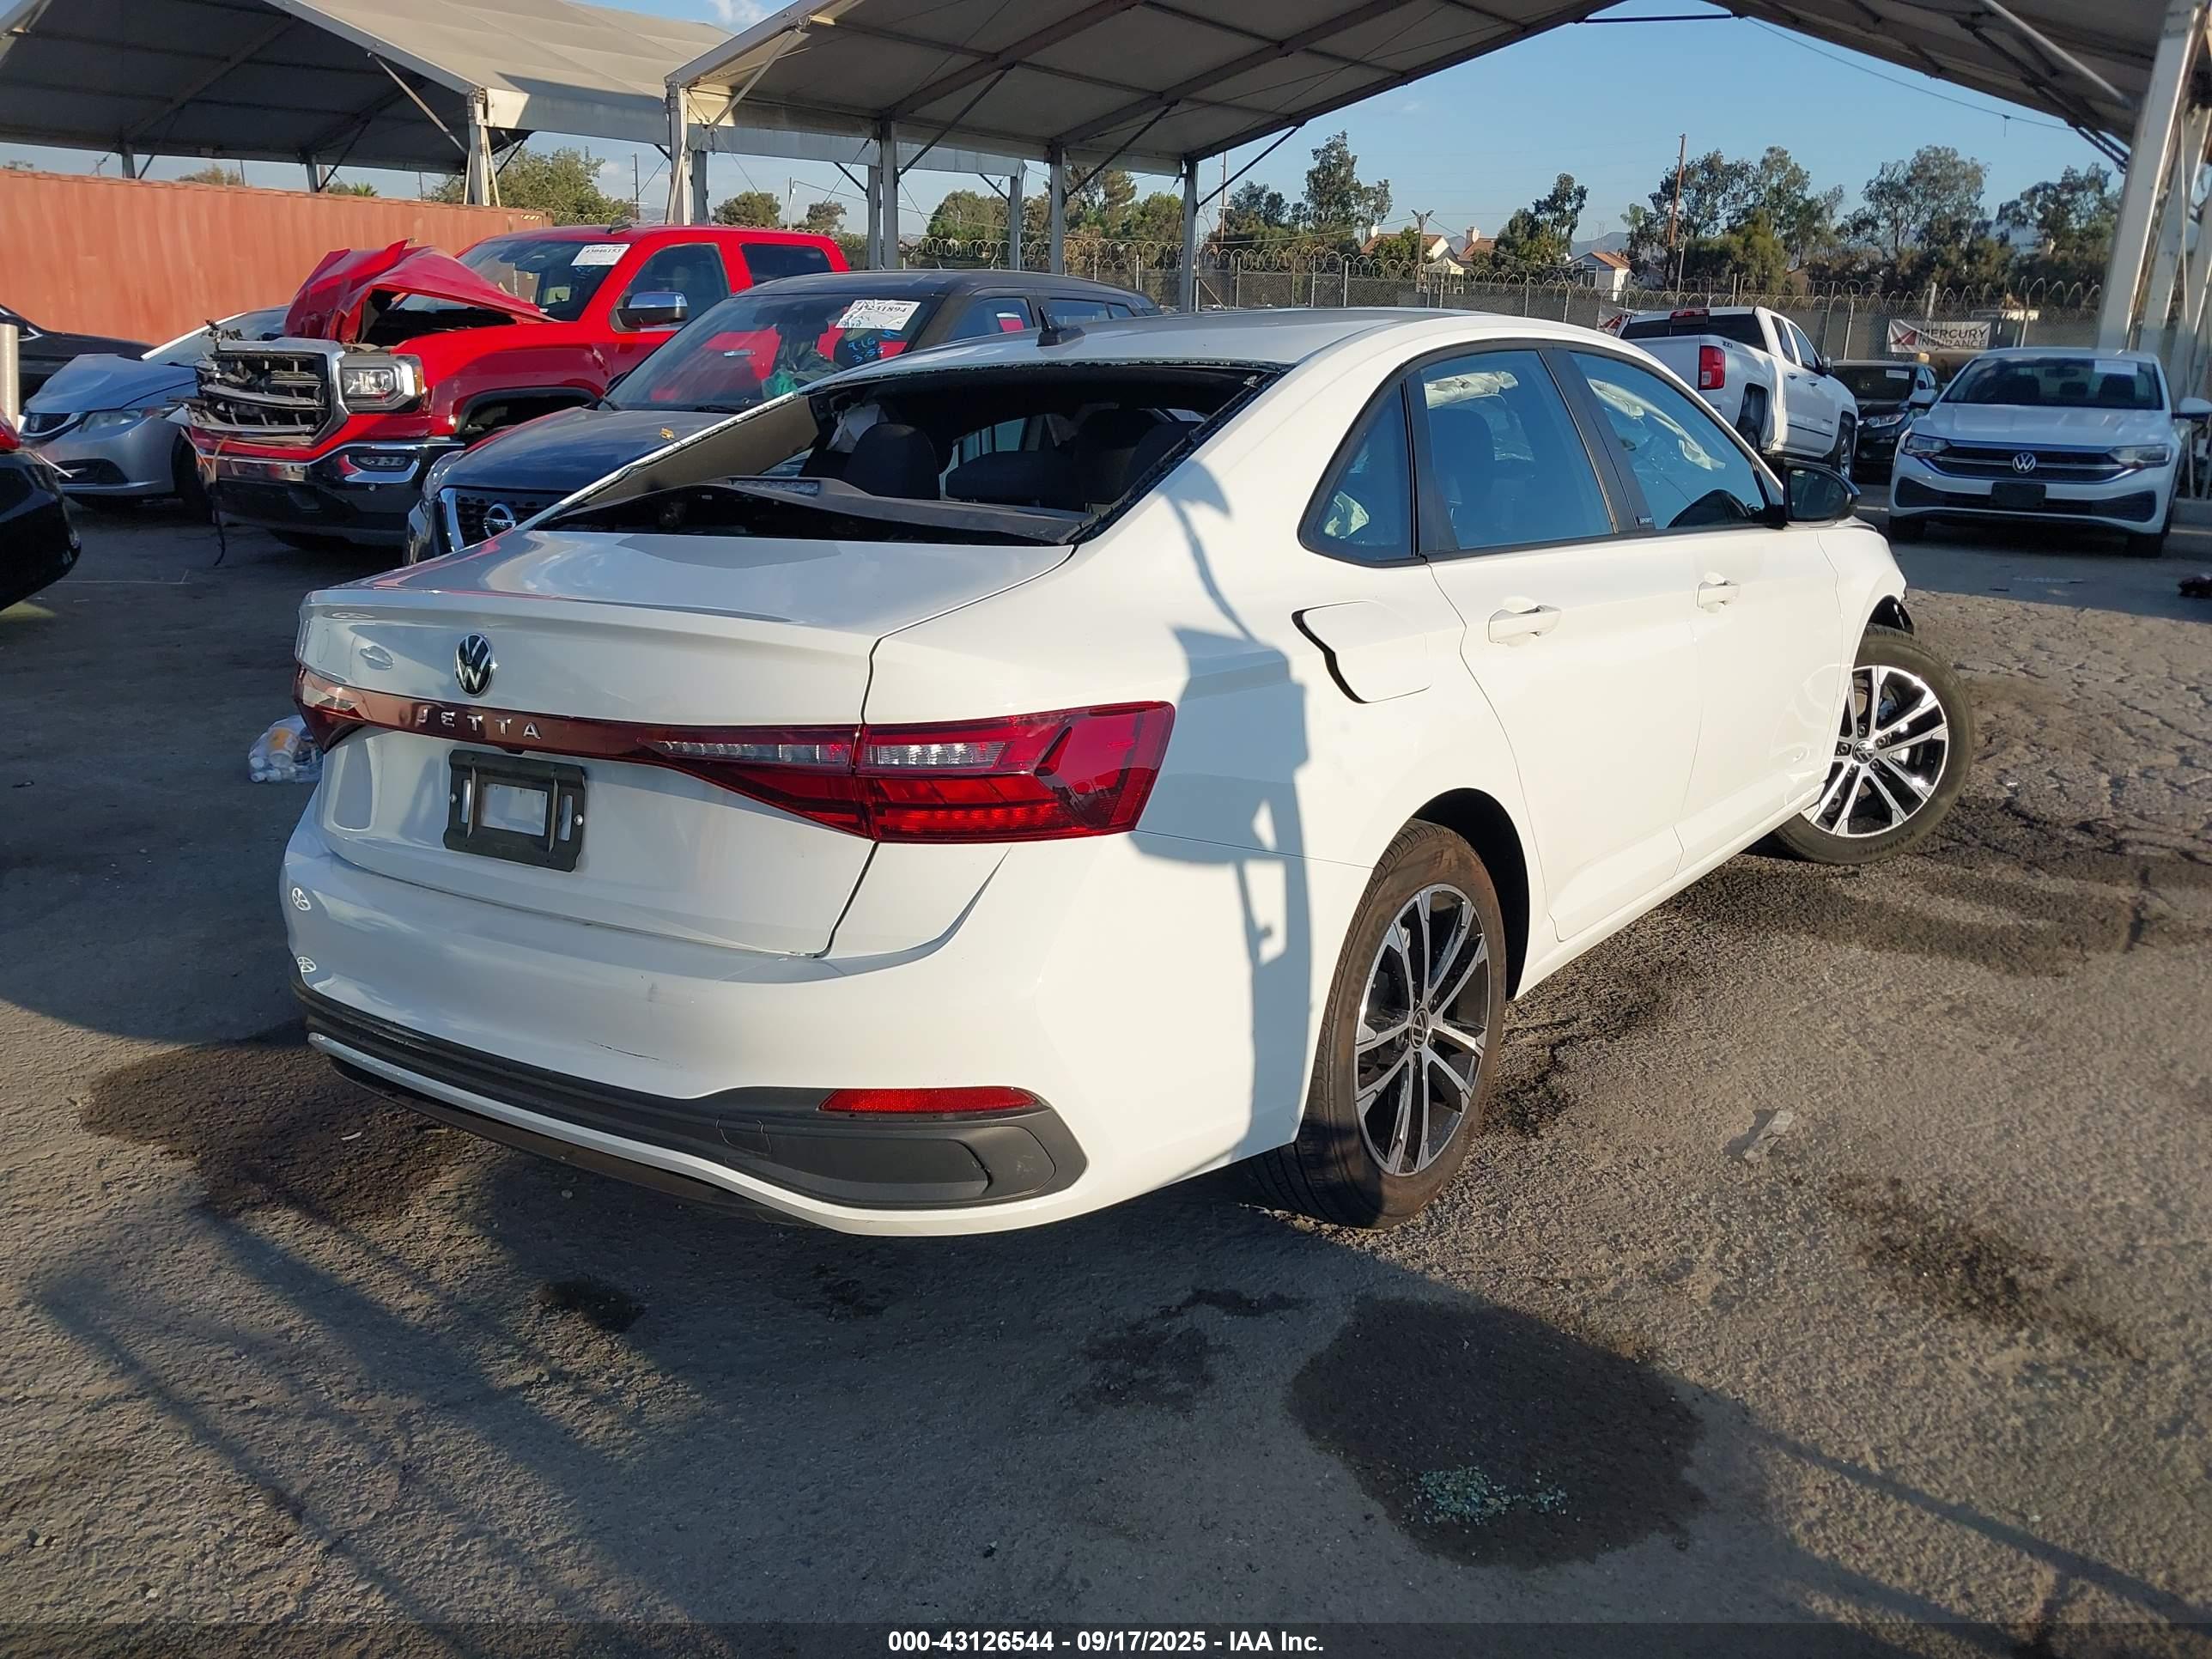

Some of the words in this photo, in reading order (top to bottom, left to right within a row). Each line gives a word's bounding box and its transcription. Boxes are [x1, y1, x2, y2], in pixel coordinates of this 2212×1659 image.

[1920, 328, 1987, 339] MERCURY
[1917, 337, 1987, 348] INSURANCE
[416, 707, 542, 740] JETTA
